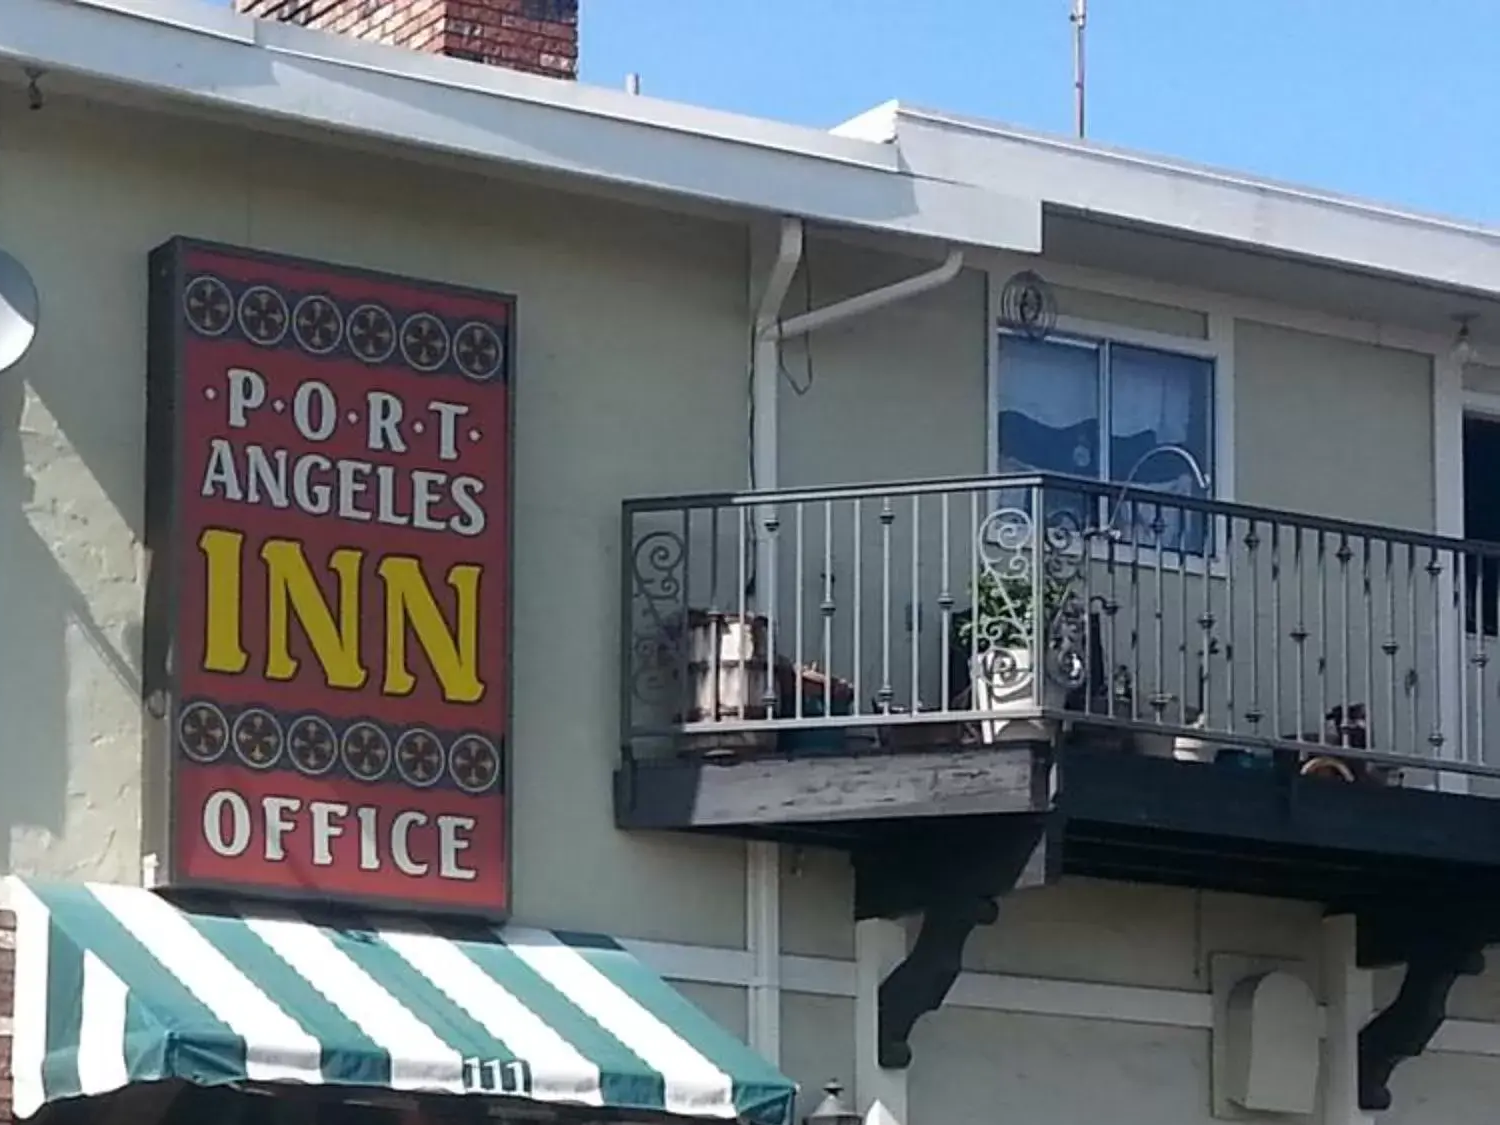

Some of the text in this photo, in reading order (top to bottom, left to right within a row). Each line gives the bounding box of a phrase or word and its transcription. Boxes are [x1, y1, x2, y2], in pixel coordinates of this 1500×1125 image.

[201, 438, 486, 537] ANGELES
[199, 528, 486, 704] INN
[202, 789, 476, 882] OFFICE
[464, 1056, 524, 1095] 111
